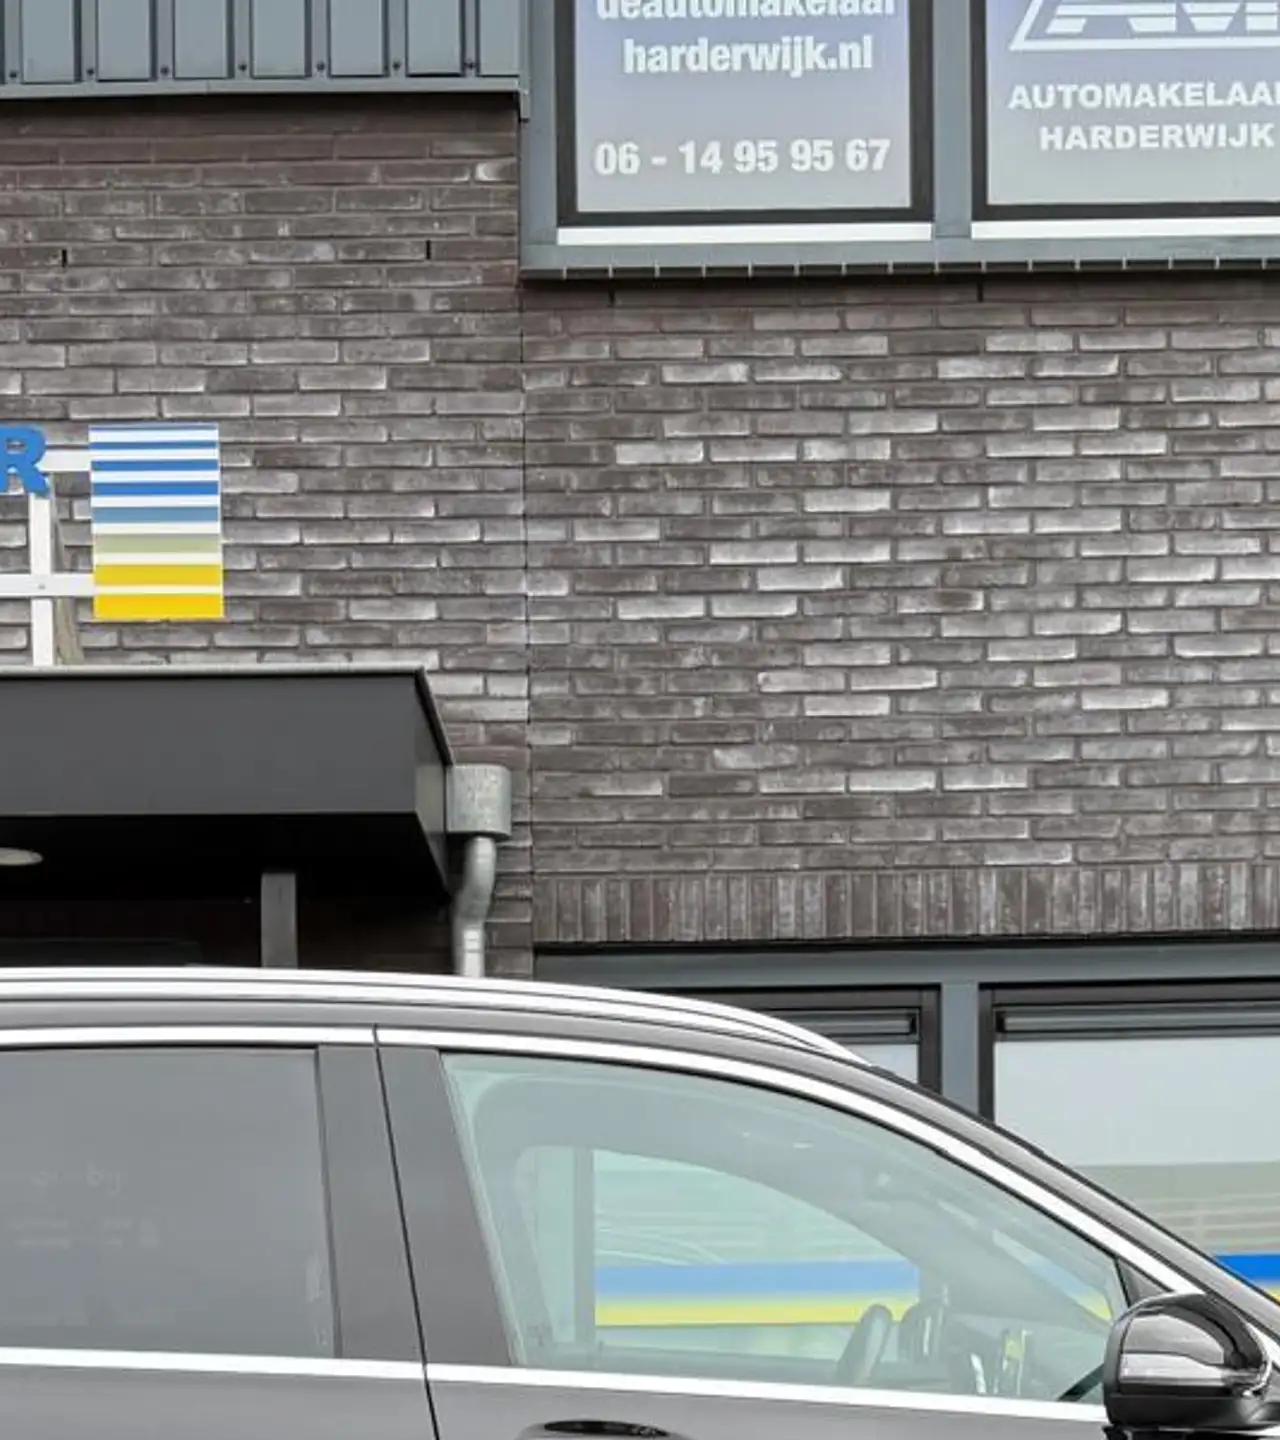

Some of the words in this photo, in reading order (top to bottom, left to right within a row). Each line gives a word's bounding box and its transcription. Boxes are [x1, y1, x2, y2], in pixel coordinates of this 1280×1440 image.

[623, 35, 874, 78] harderwijk.nl
[1039, 123, 1275, 151] HARDERWIJK
[594, 142, 641, 175] 06
[677, 140, 724, 174] 14
[733, 140, 780, 172] 95
[790, 138, 835, 172] 95
[846, 138, 891, 171] 67
